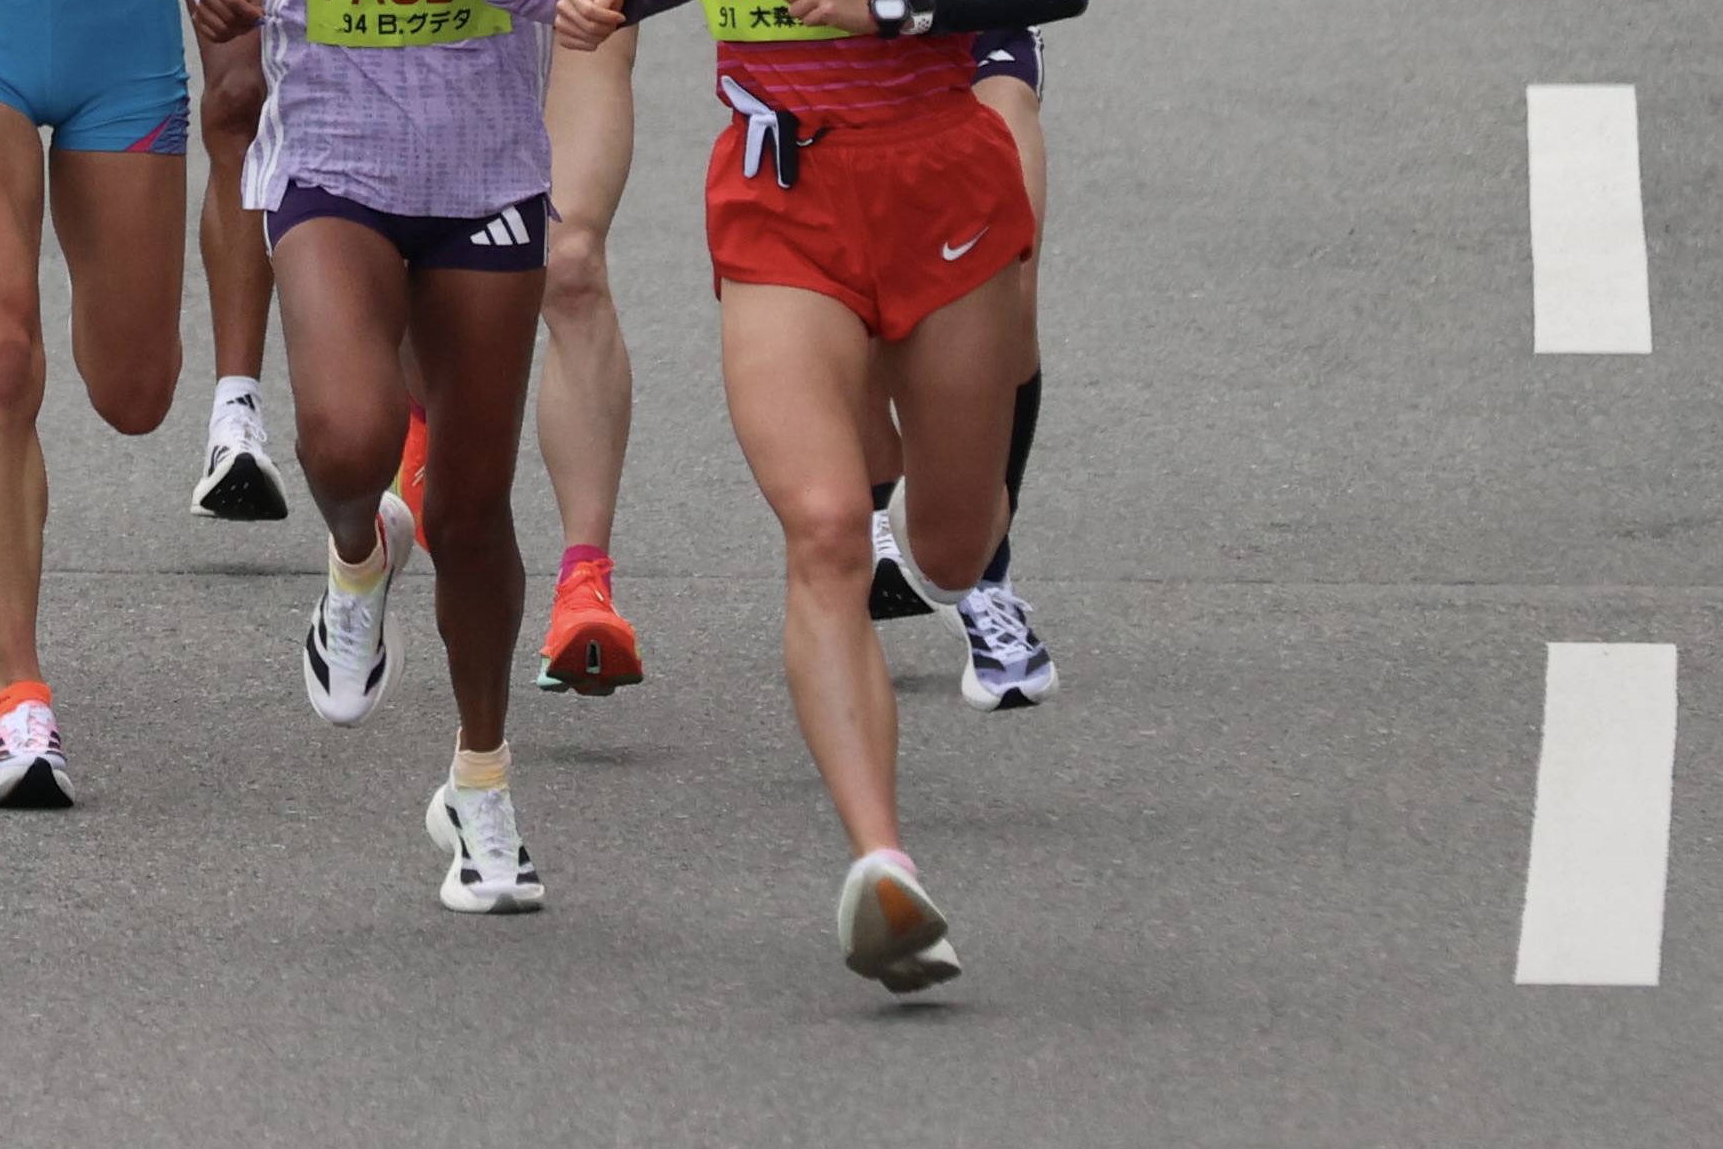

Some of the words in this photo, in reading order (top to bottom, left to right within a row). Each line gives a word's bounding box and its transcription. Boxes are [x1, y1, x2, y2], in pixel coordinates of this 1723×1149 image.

[342, 13, 367, 34] 94
[377, 8, 471, 35] B.グデタ
[719, 6, 737, 28] 91
[749, 6, 806, 29] 大森
